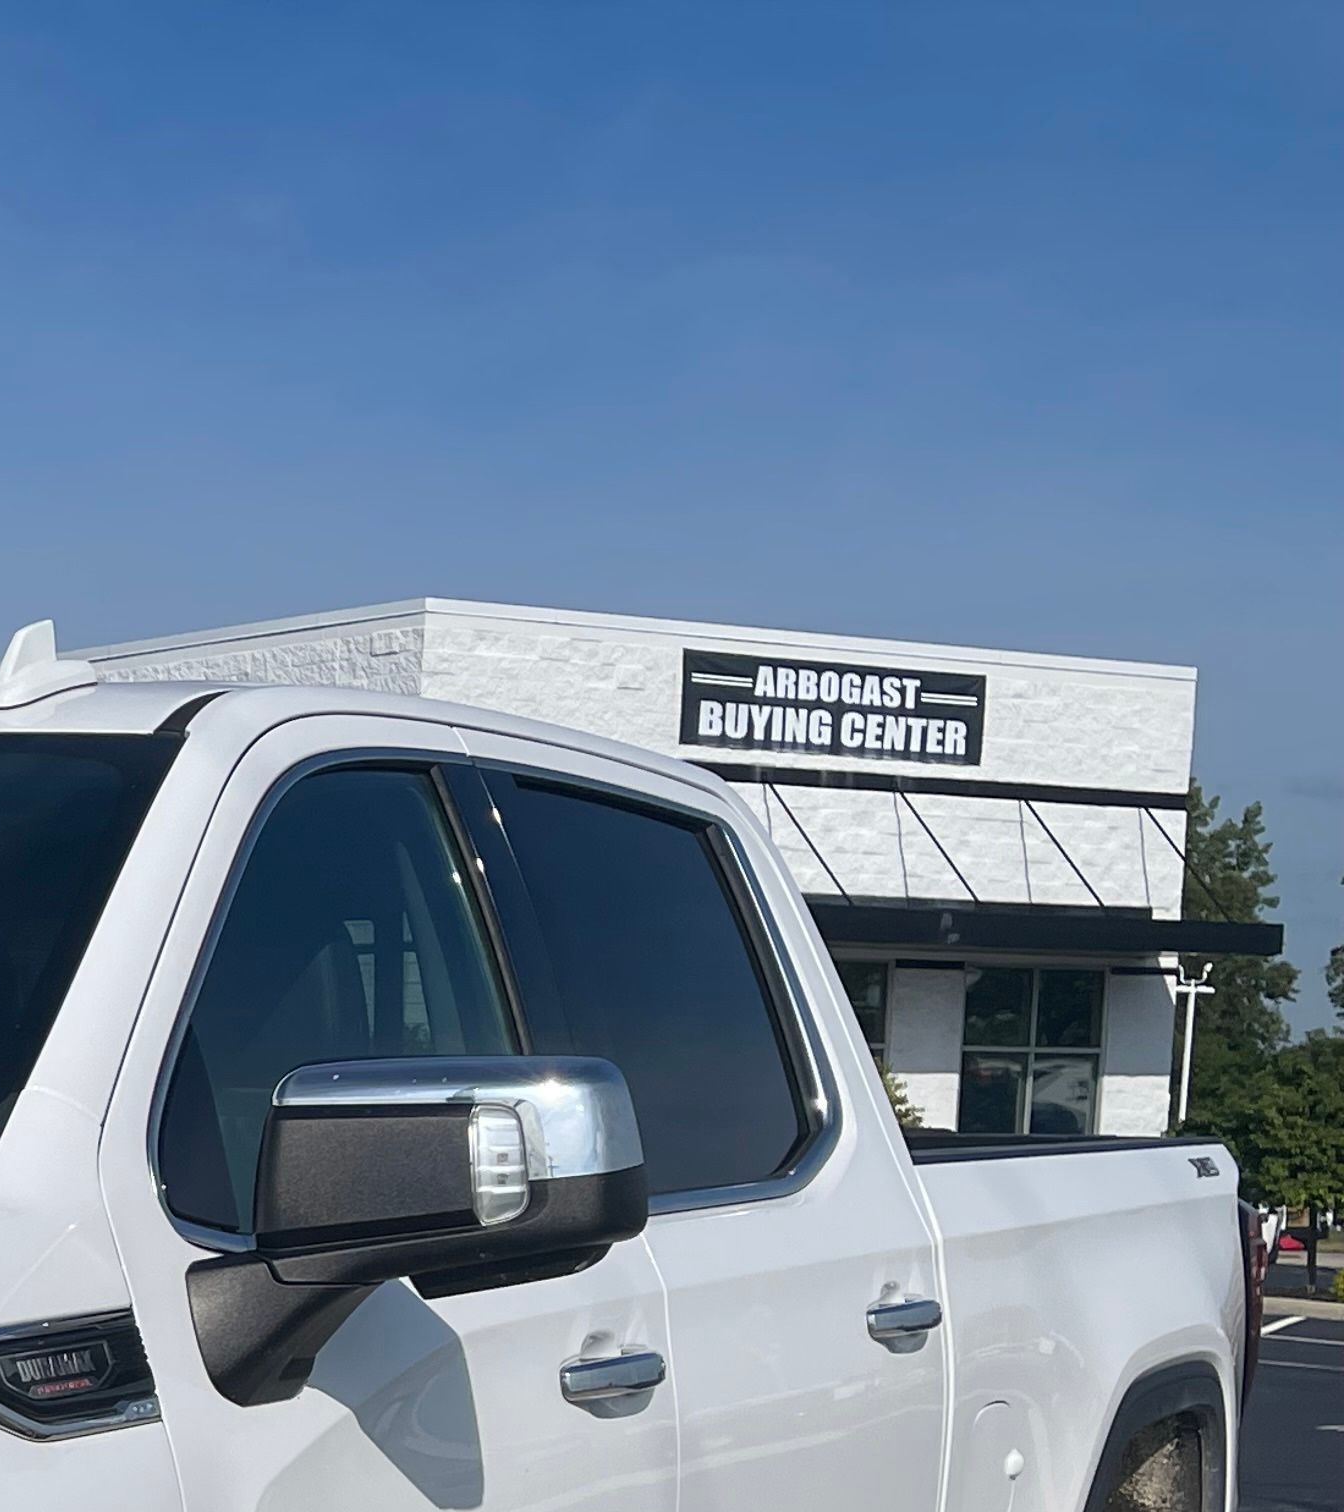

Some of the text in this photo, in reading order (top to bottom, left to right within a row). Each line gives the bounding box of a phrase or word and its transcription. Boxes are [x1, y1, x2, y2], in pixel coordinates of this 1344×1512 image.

[754, 665, 921, 709] ARBOGAST
[698, 700, 968, 756] BUYING CENTER
